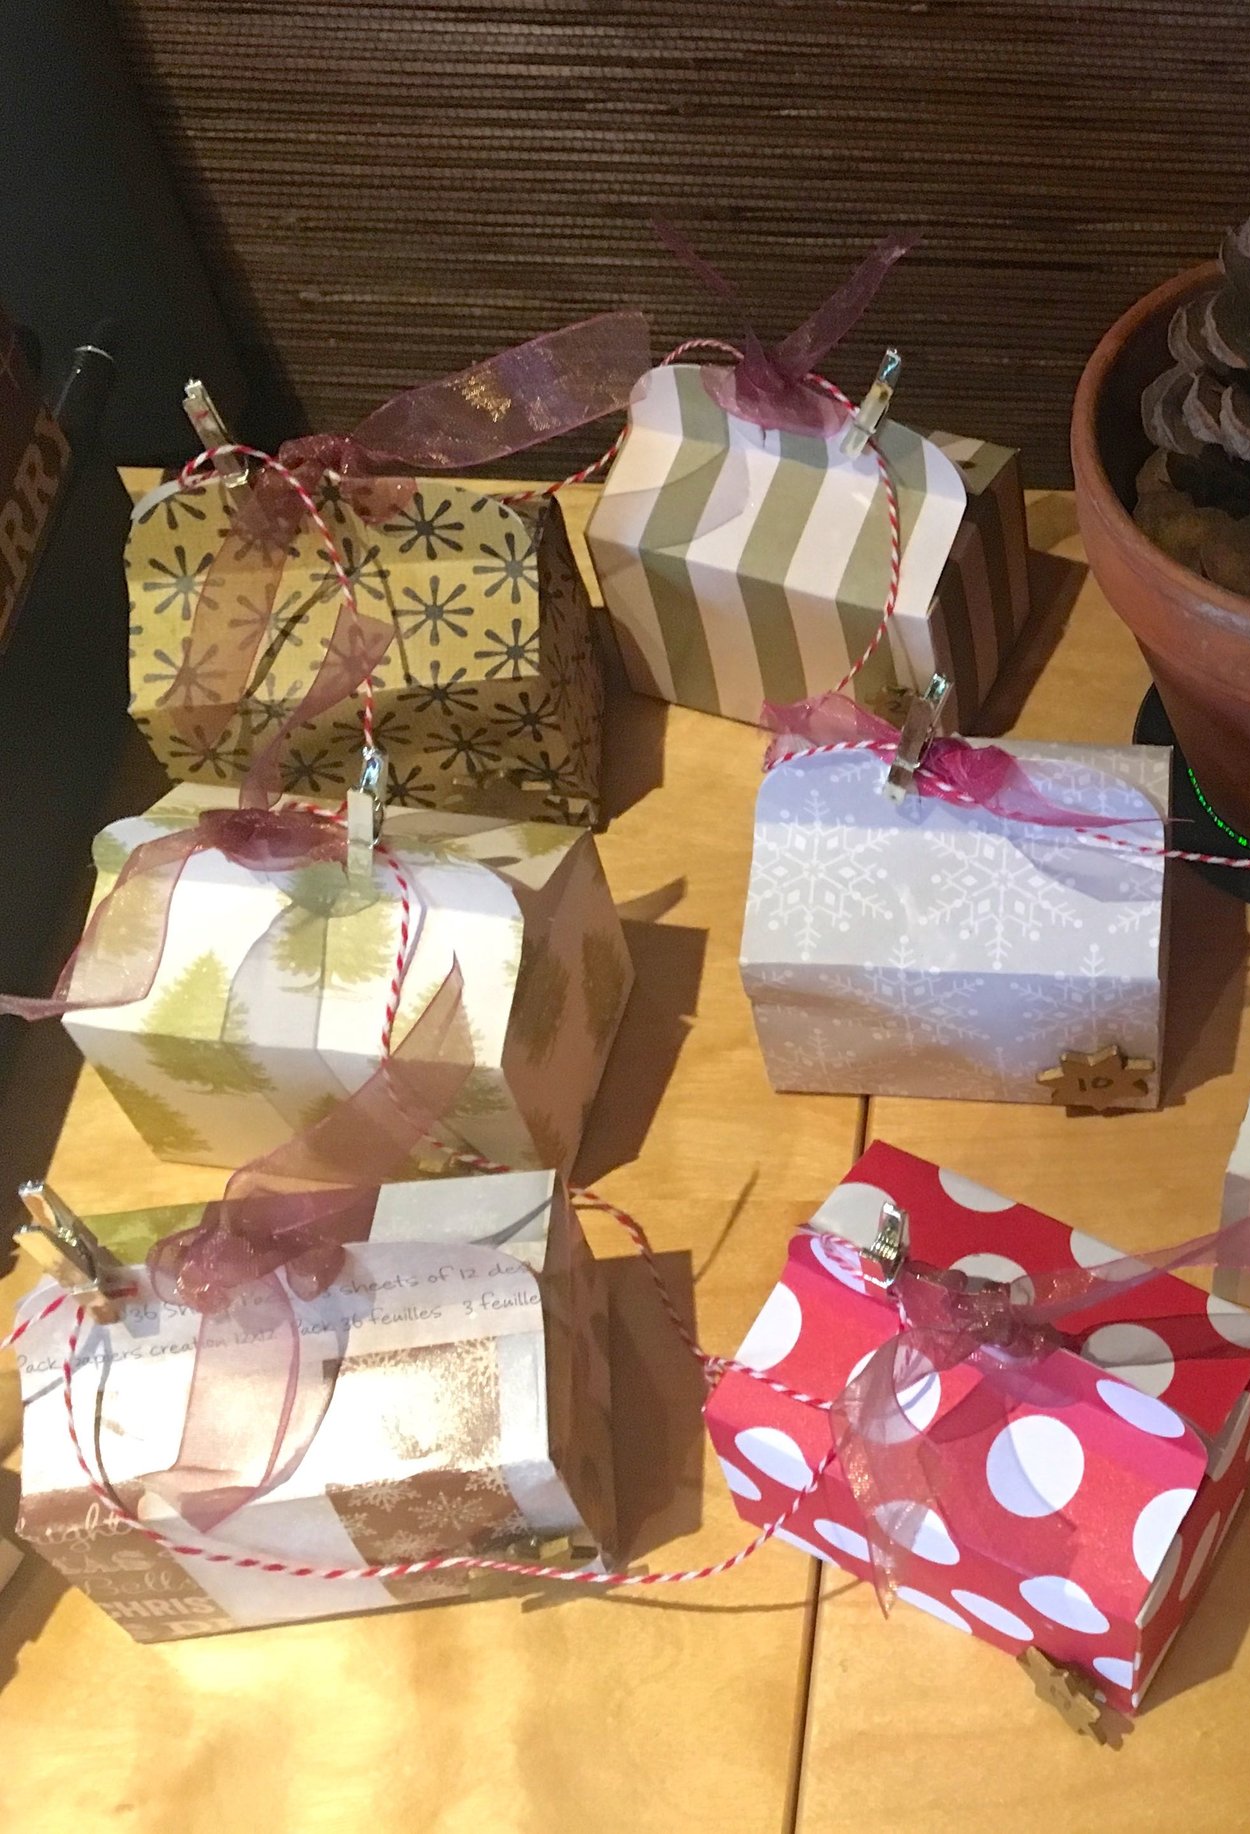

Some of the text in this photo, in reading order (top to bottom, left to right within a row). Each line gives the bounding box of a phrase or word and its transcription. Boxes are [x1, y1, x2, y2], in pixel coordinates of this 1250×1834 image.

[1078, 1077, 1114, 1092] 10
[339, 1274, 419, 1296] sheets
[427, 1265, 454, 1283] of
[459, 1268, 480, 1281] 12
[16, 1353, 62, 1374] Pack
[339, 1313, 364, 1332] 36
[368, 1305, 442, 1325] feuilles
[462, 1300, 474, 1315] 3
